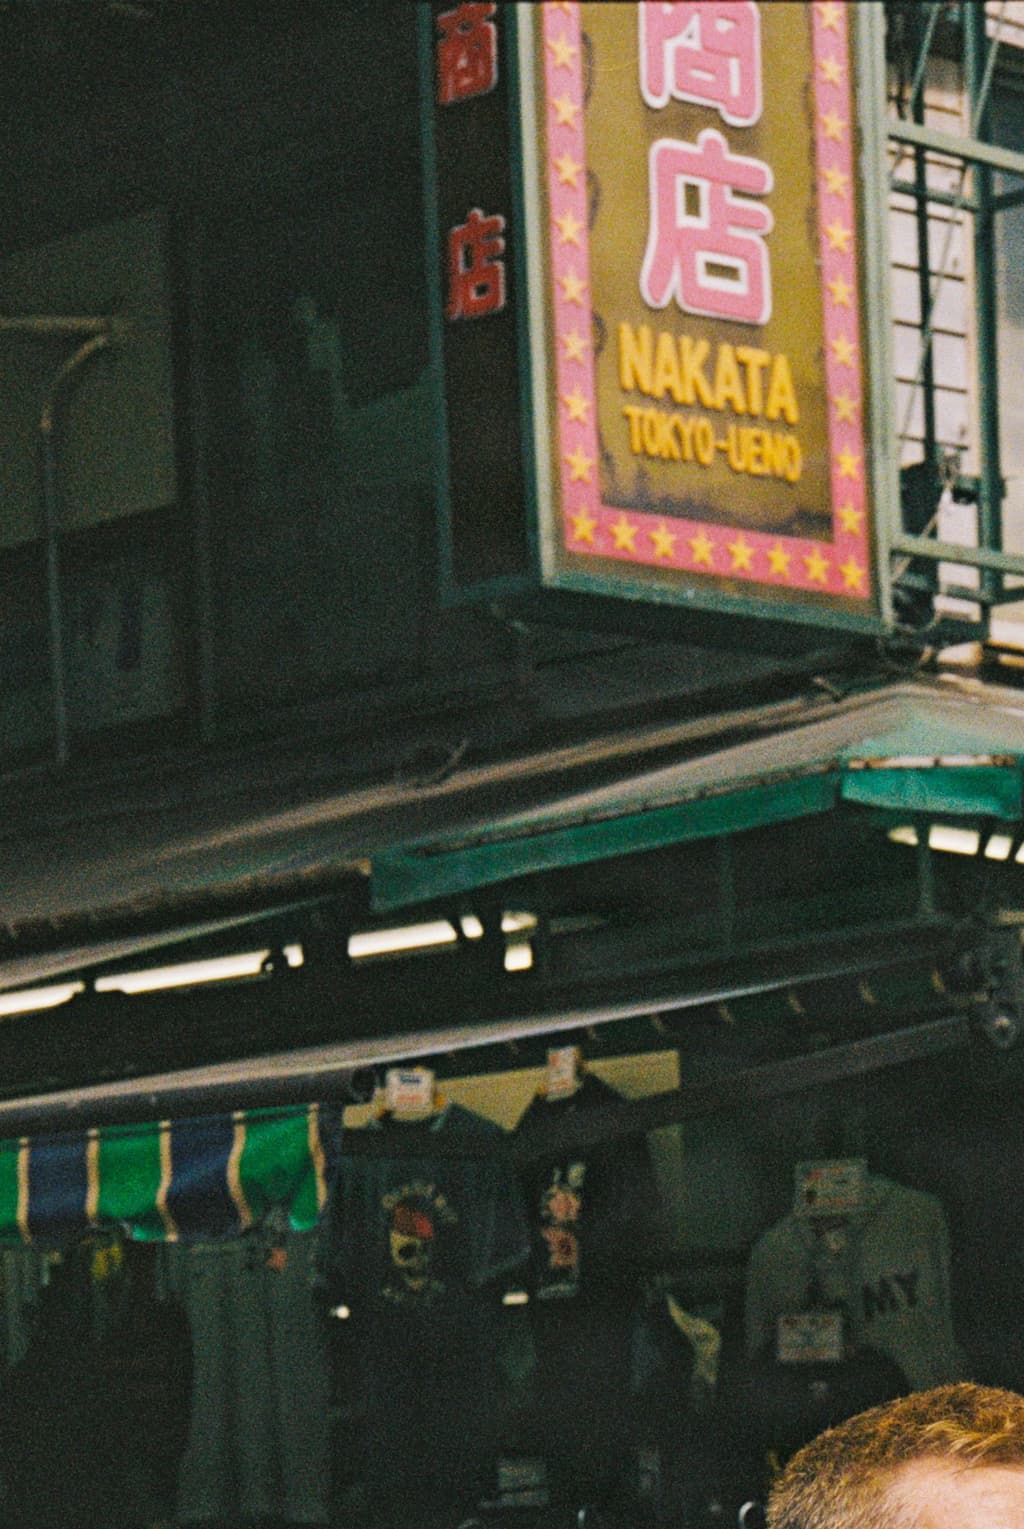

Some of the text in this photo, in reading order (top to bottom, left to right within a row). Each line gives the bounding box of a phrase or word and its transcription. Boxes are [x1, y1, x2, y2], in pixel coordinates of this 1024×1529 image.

[437, 3, 505, 320] 商店
[618, 322, 799, 425] NAKATA
[623, 404, 801, 483] TOKYO-UENO
